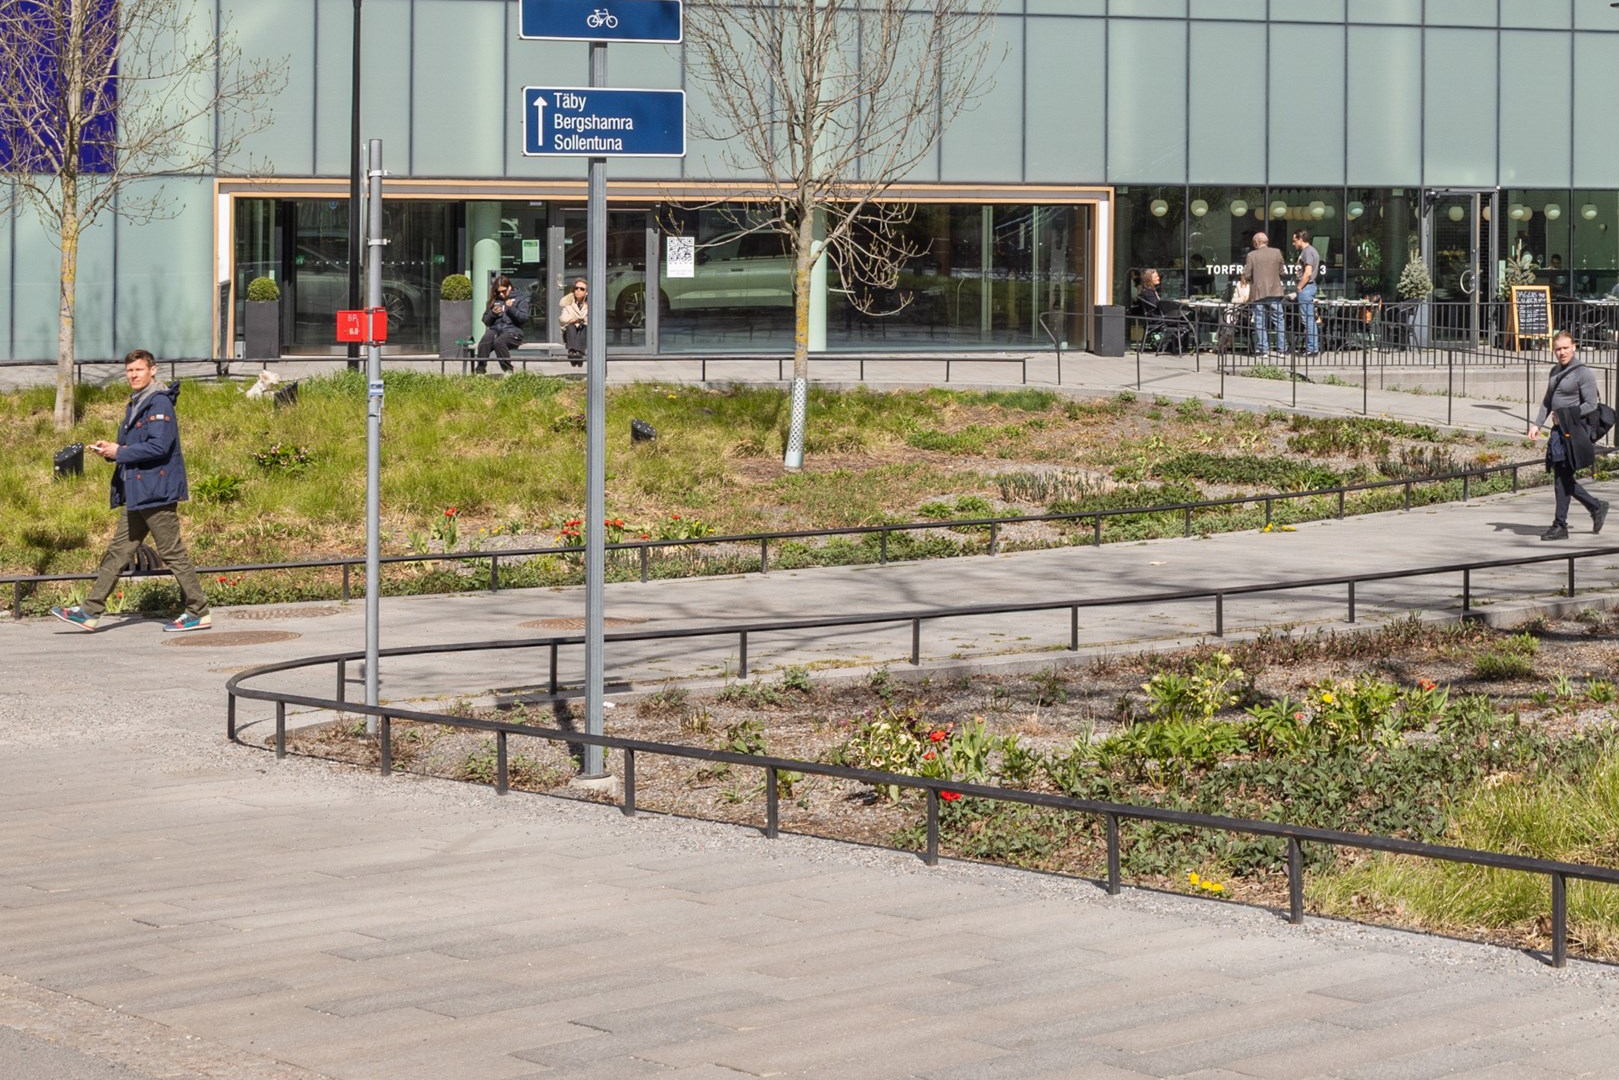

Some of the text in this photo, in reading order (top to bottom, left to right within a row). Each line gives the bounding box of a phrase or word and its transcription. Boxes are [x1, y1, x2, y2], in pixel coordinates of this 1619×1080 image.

[553, 92, 587, 112] Täby
[554, 113, 634, 133] Bergshamra
[554, 133, 623, 151] Sollentuna
